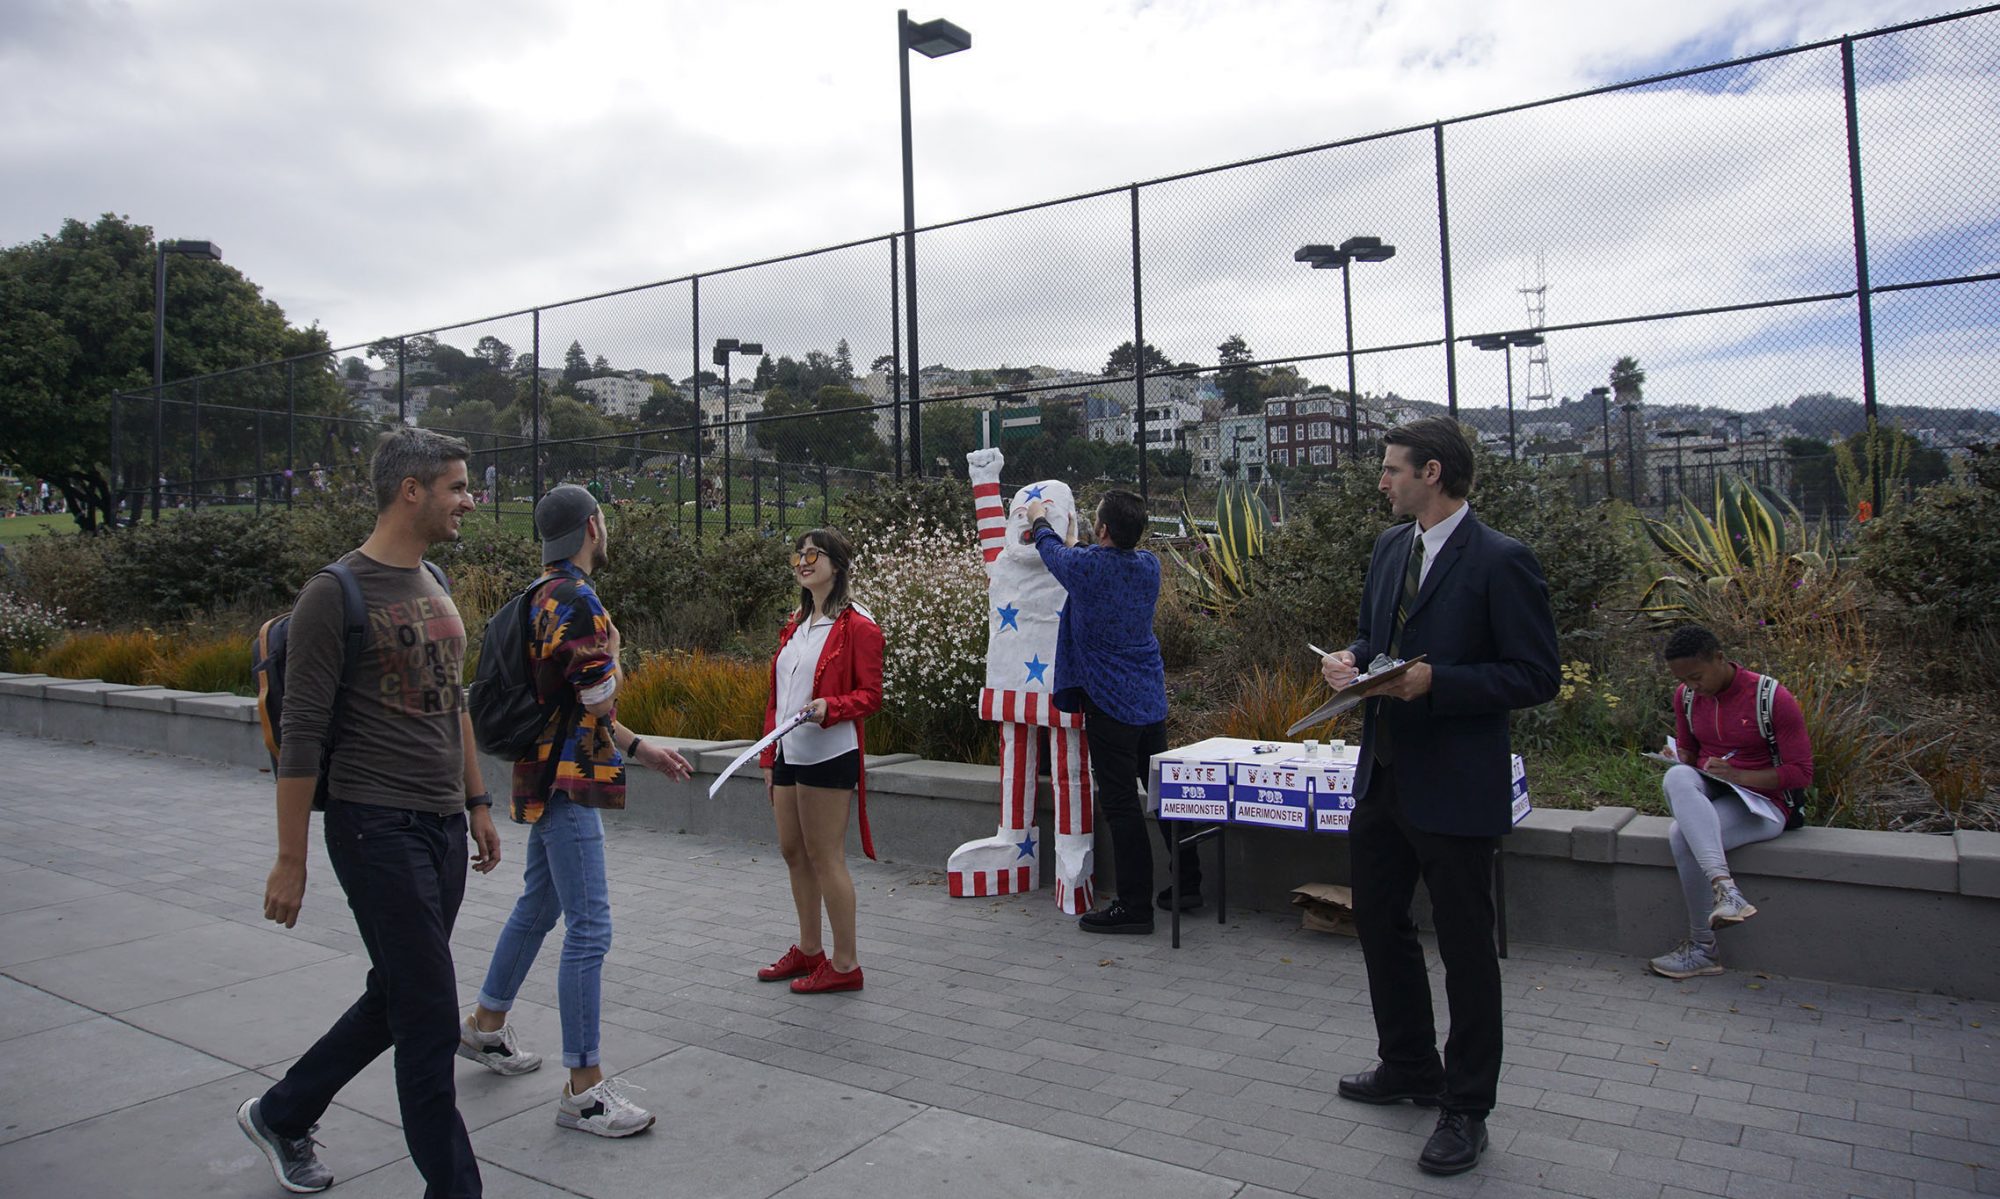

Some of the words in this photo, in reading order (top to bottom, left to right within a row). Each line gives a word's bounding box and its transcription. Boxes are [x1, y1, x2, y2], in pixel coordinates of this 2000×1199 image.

[1181, 785, 1206, 799] FOR
[1257, 789, 1284, 804] FOR
[1164, 802, 1225, 815] AMERIMONSTER
[1338, 795, 1356, 809] FO
[1238, 805, 1303, 822] AMERIMONSTER
